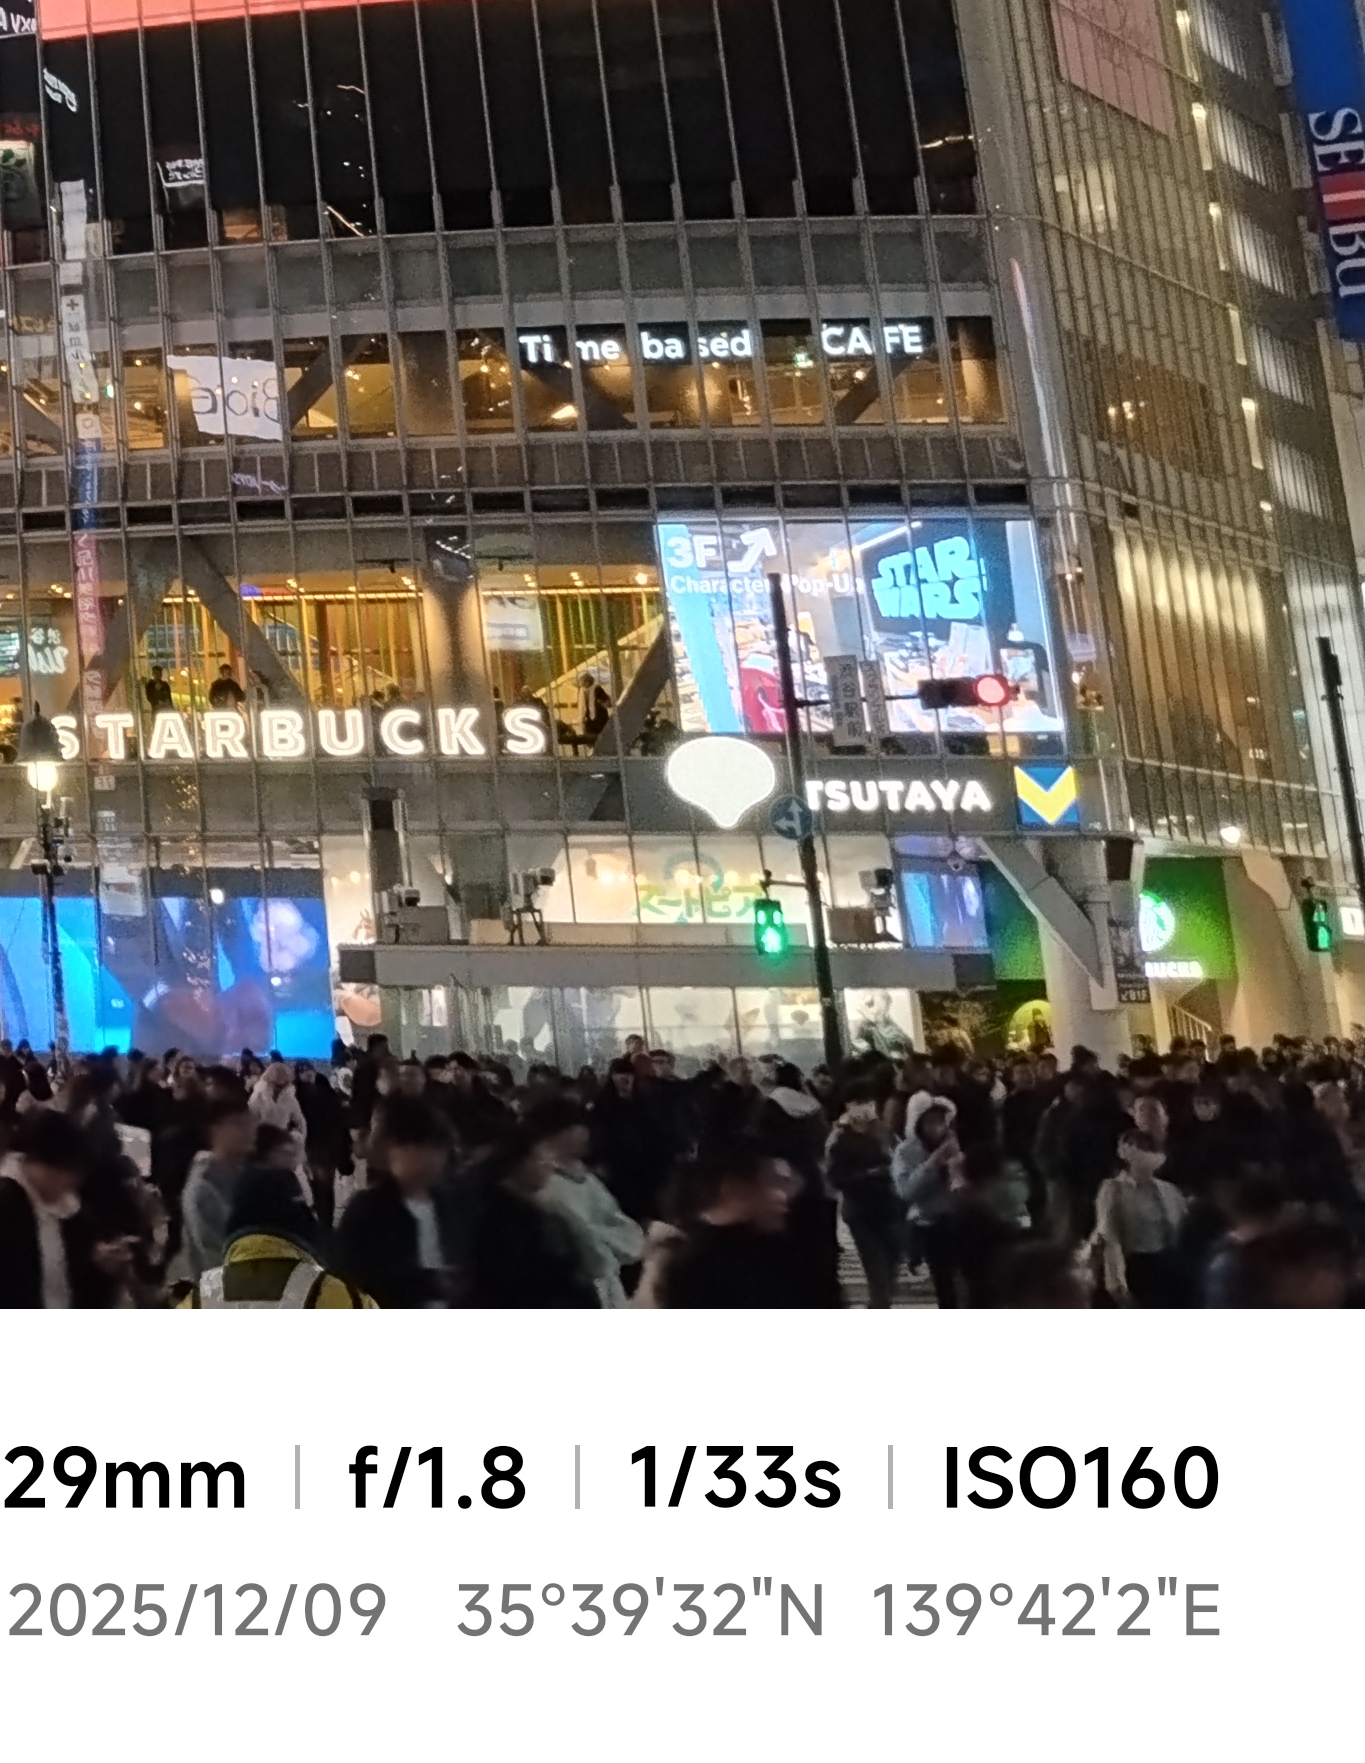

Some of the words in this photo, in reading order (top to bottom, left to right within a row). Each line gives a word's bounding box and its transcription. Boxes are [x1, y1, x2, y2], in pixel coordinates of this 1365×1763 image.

[517, 333, 621, 364] Time
[640, 329, 752, 359] based
[820, 324, 923, 356] CAFE
[669, 535, 717, 569] 3F
[876, 535, 971, 589] STAR
[872, 578, 982, 620] WARS
[51, 708, 547, 760] STARBUCKS
[805, 779, 993, 812] TSUTAYA
